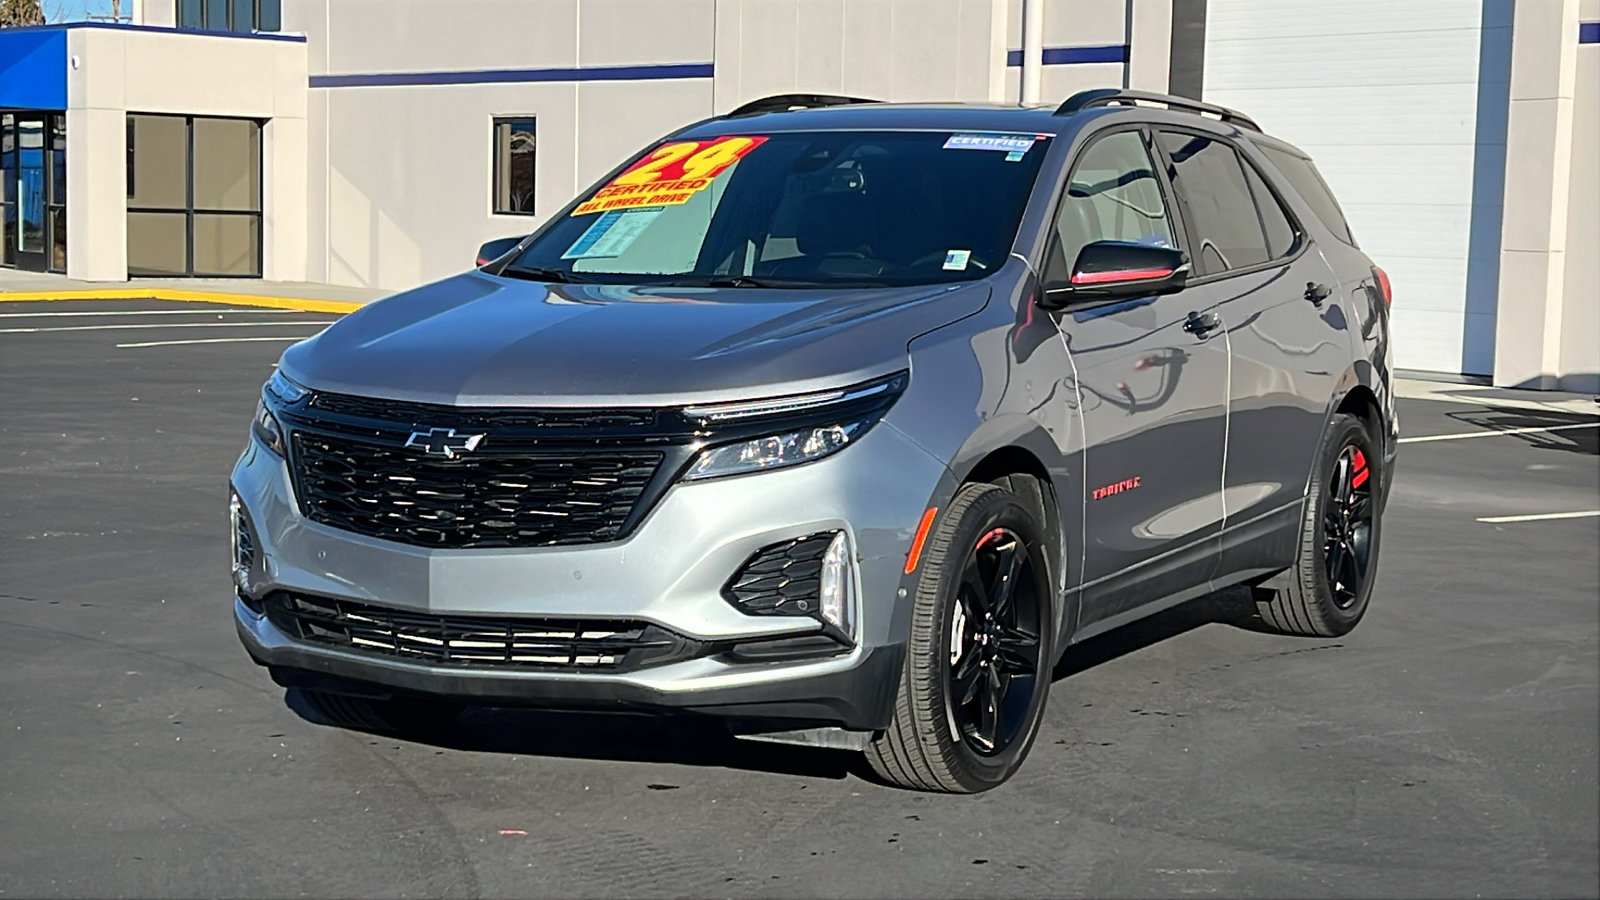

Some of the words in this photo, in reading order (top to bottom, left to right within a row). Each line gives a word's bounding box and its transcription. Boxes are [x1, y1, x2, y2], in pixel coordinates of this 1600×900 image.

[952, 137, 1029, 147] CERTIFIED
[611, 137, 753, 187] 24
[597, 179, 708, 199] CERTIFIED
[577, 201, 604, 213] ALL
[603, 196, 647, 208] WHEEL
[647, 193, 691, 204] DRIVE
